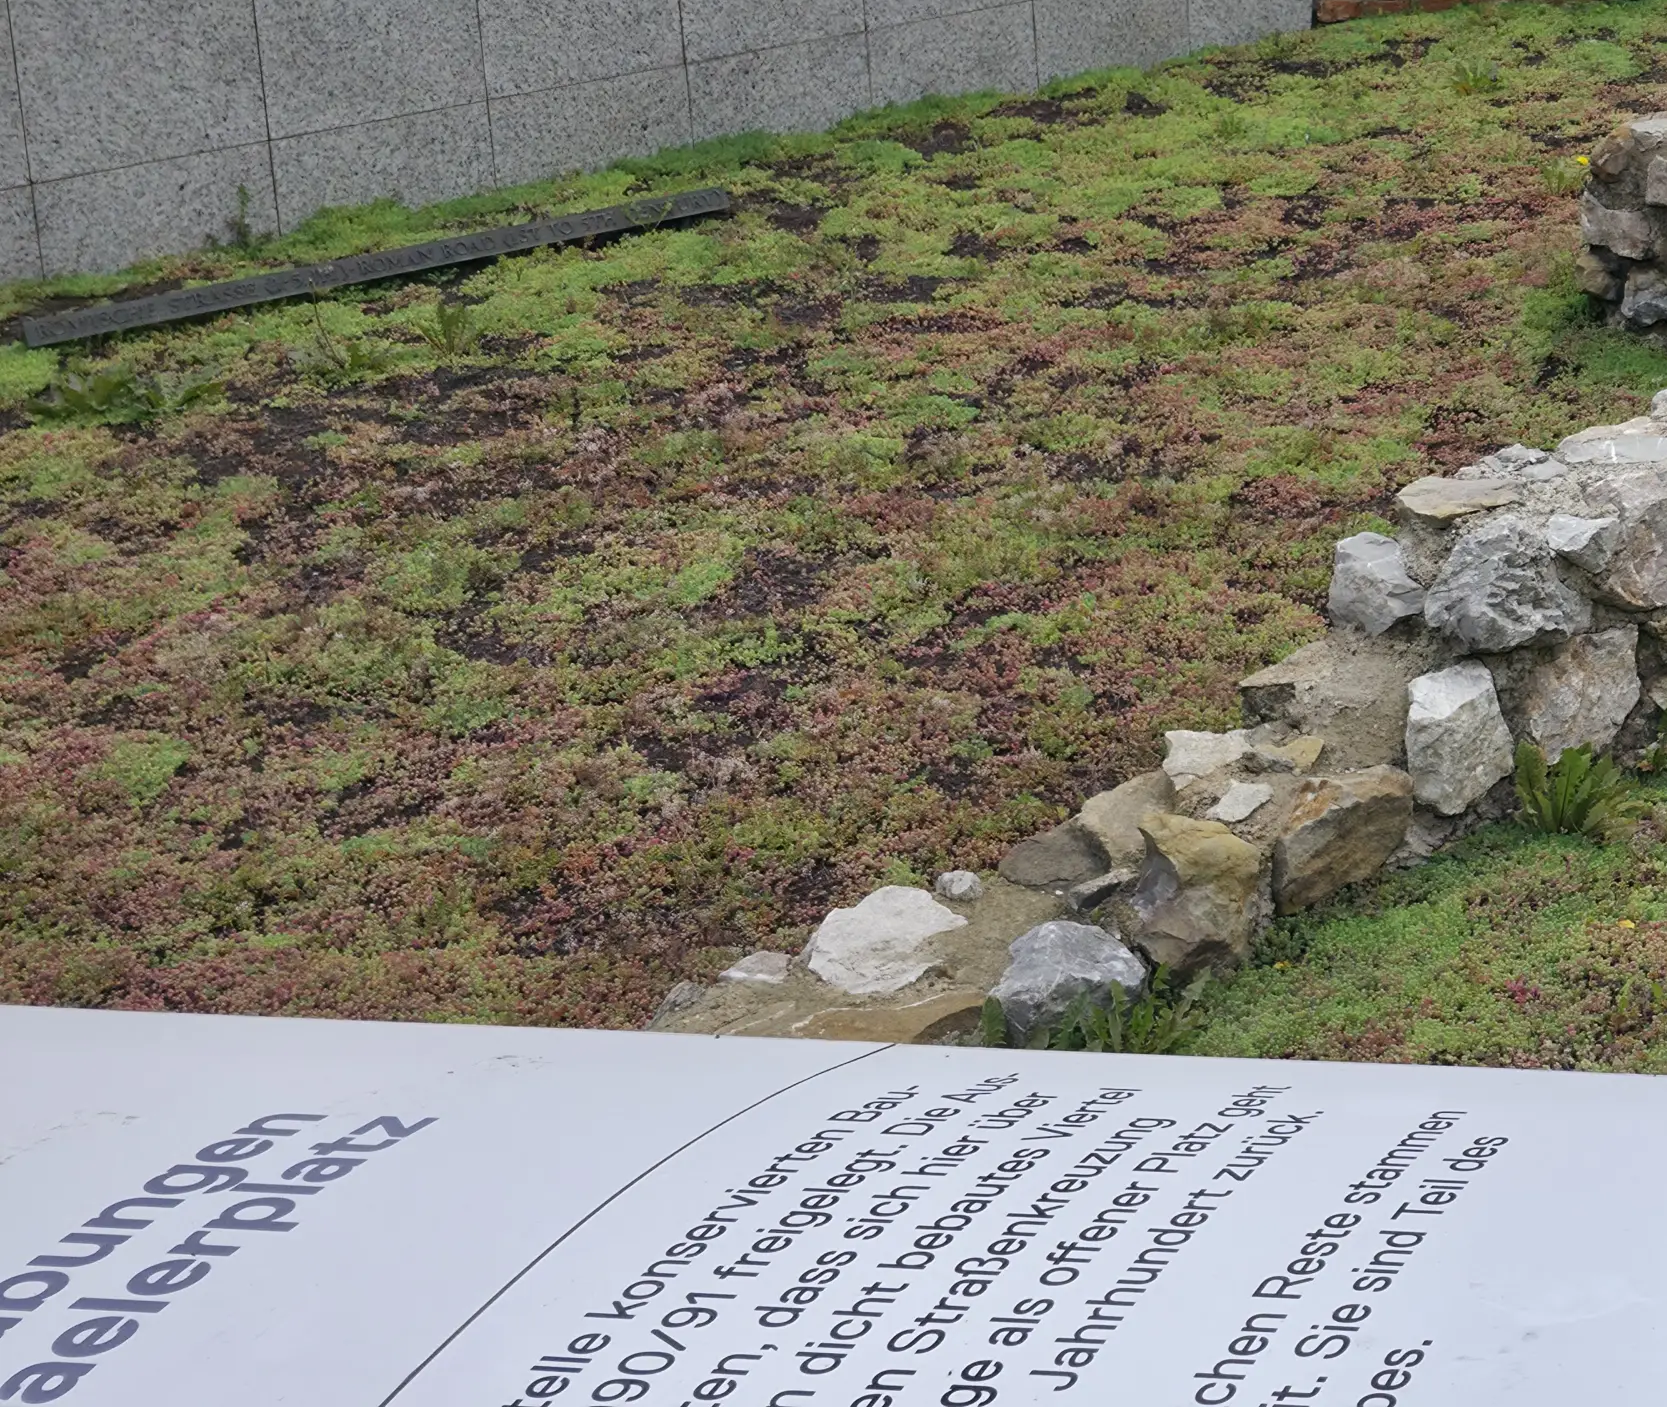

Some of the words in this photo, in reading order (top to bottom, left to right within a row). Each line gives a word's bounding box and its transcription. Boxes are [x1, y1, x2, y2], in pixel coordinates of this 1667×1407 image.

[0, 1113, 328, 1338] bungen
[584, 1128, 855, 1321] konservierten
[827, 1085, 920, 1123] Bau-
[588, 1291, 738, 1407] 90/91
[713, 1144, 909, 1281] freigelegt.
[880, 1106, 961, 1137] Die
[940, 1072, 1020, 1103] Aus-
[679, 1342, 779, 1407] en,
[754, 1250, 857, 1328] dass
[843, 1185, 931, 1240] sich
[901, 1134, 989, 1176] hier
[968, 1091, 1058, 1130] über
[795, 1281, 910, 1375] dicht
[877, 1147, 1051, 1270] bebautes
[1020, 1087, 1143, 1141] Viertel
[886, 1116, 1177, 1354] Straßenkreuzung
[988, 1297, 1055, 1347] als
[1039, 1181, 1160, 1287] offener
[1133, 1122, 1235, 1174] Platz
[1217, 1084, 1292, 1118] geht
[1029, 1189, 1234, 1392] Jahrhundert
[1212, 1110, 1325, 1182] zurück.
[1193, 1313, 1288, 1406] chen
[1251, 1212, 1362, 1300] Reste
[1343, 1110, 1468, 1205] stammen
[1294, 1303, 1372, 1360] Sie
[1351, 1230, 1428, 1292] sind
[1390, 1178, 1470, 1220] Teil
[1442, 1135, 1509, 1172] des
